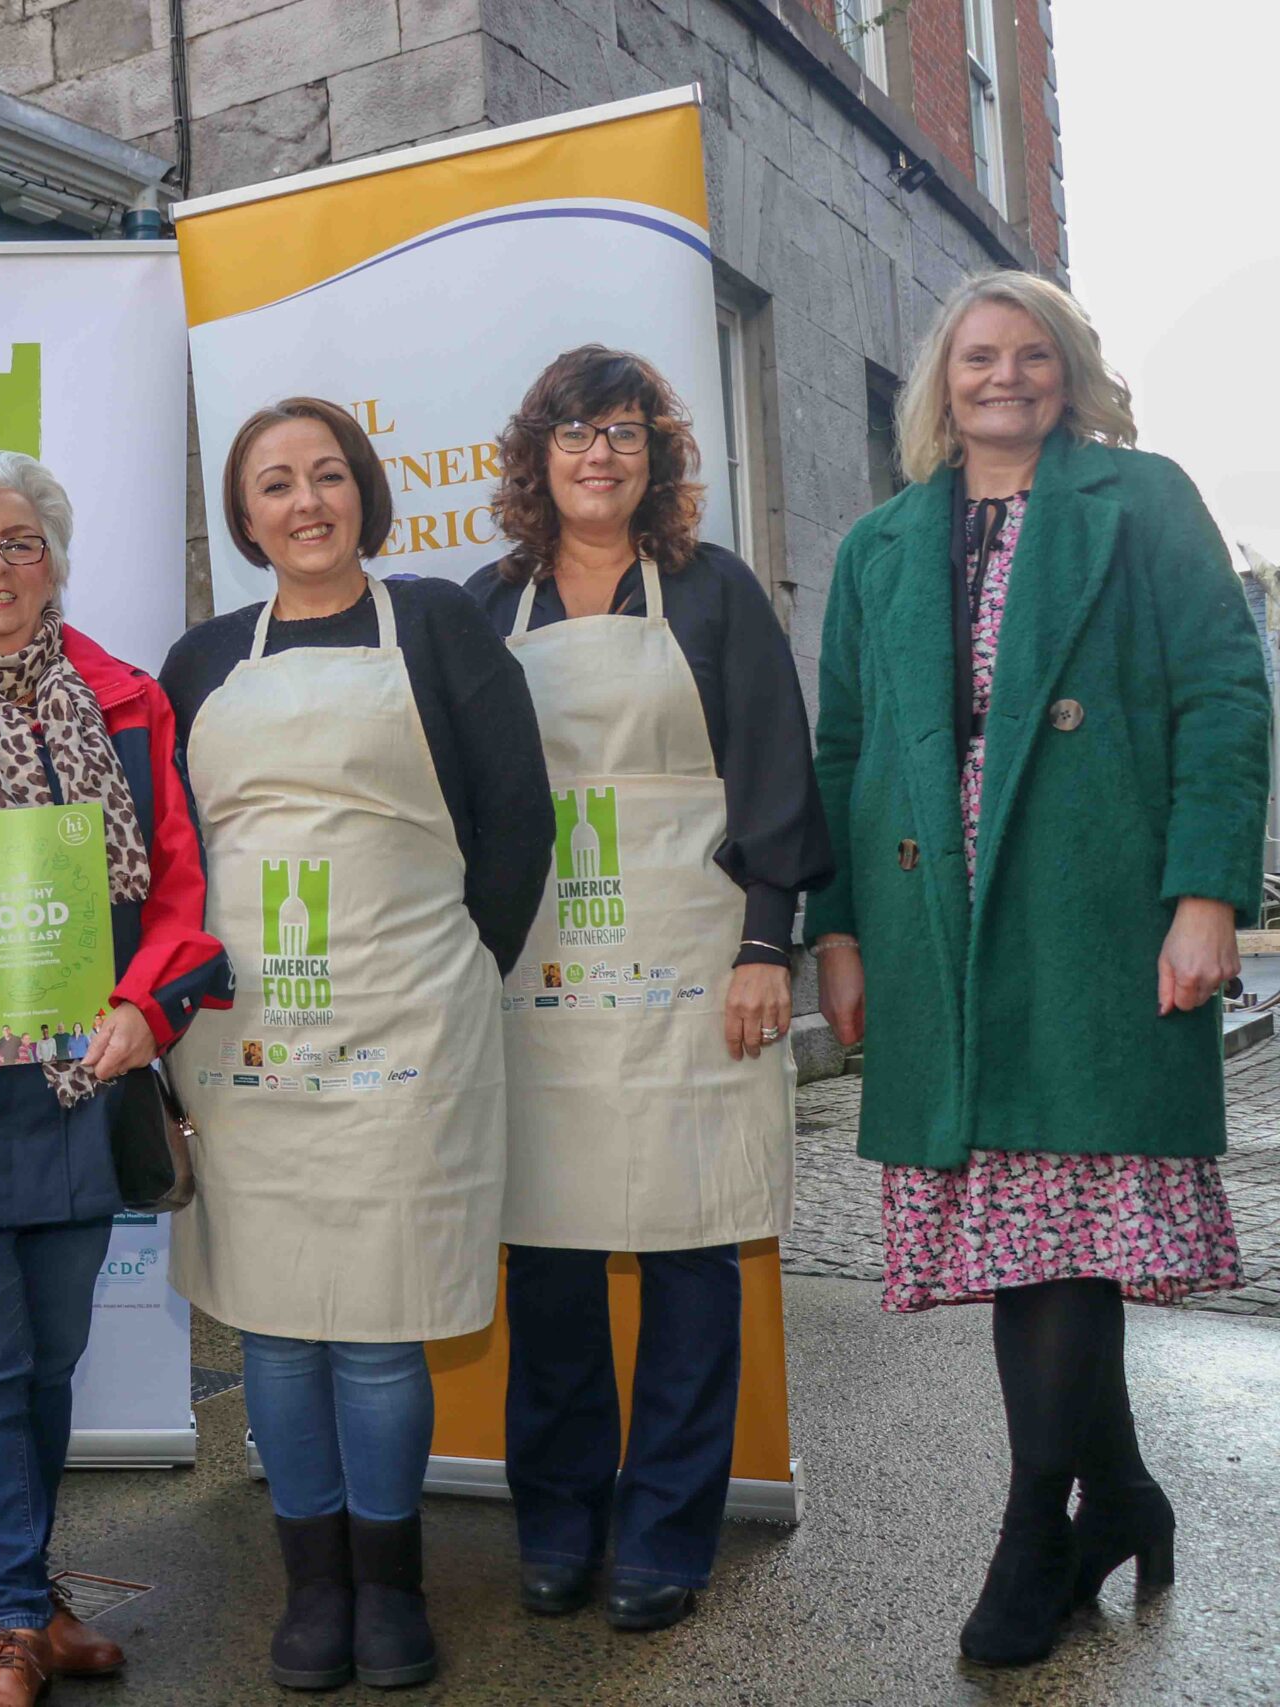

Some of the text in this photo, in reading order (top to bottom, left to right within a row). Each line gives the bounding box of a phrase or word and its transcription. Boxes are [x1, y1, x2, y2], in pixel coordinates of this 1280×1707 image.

[65, 817, 84, 834] hi
[557, 880, 622, 899] LIMERICK
[558, 898, 625, 930] FOOD
[30, 929, 62, 942] EASY
[559, 928, 626, 946] PARTNERSHIP
[262, 958, 329, 977] LIMERICK
[262, 977, 333, 1009] FOOD
[263, 1009, 334, 1027] PARTNERSHIP
[303, 1053, 322, 1061] CYPSC
[367, 1048, 385, 1057] MIC
[353, 1071, 381, 1085] SVP
[99, 1262, 145, 1275] CDC
